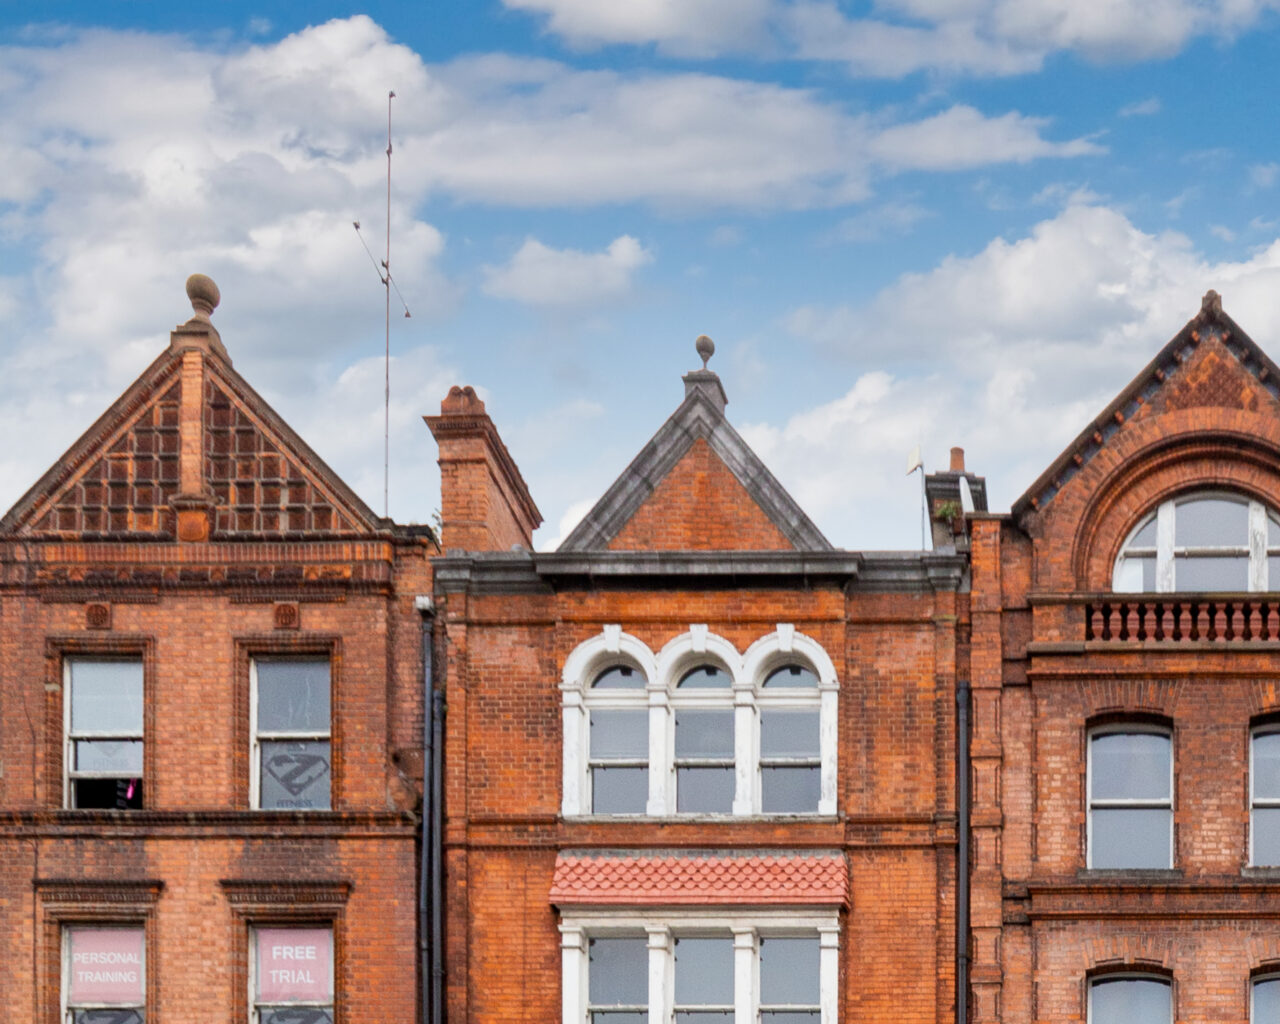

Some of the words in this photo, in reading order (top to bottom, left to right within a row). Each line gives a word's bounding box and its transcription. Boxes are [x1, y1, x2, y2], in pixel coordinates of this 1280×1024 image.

[73, 952, 141, 964] PERSONAL
[272, 945, 317, 960] FREE
[77, 971, 137, 983] TRAINING
[269, 969, 315, 984] TRIAL
